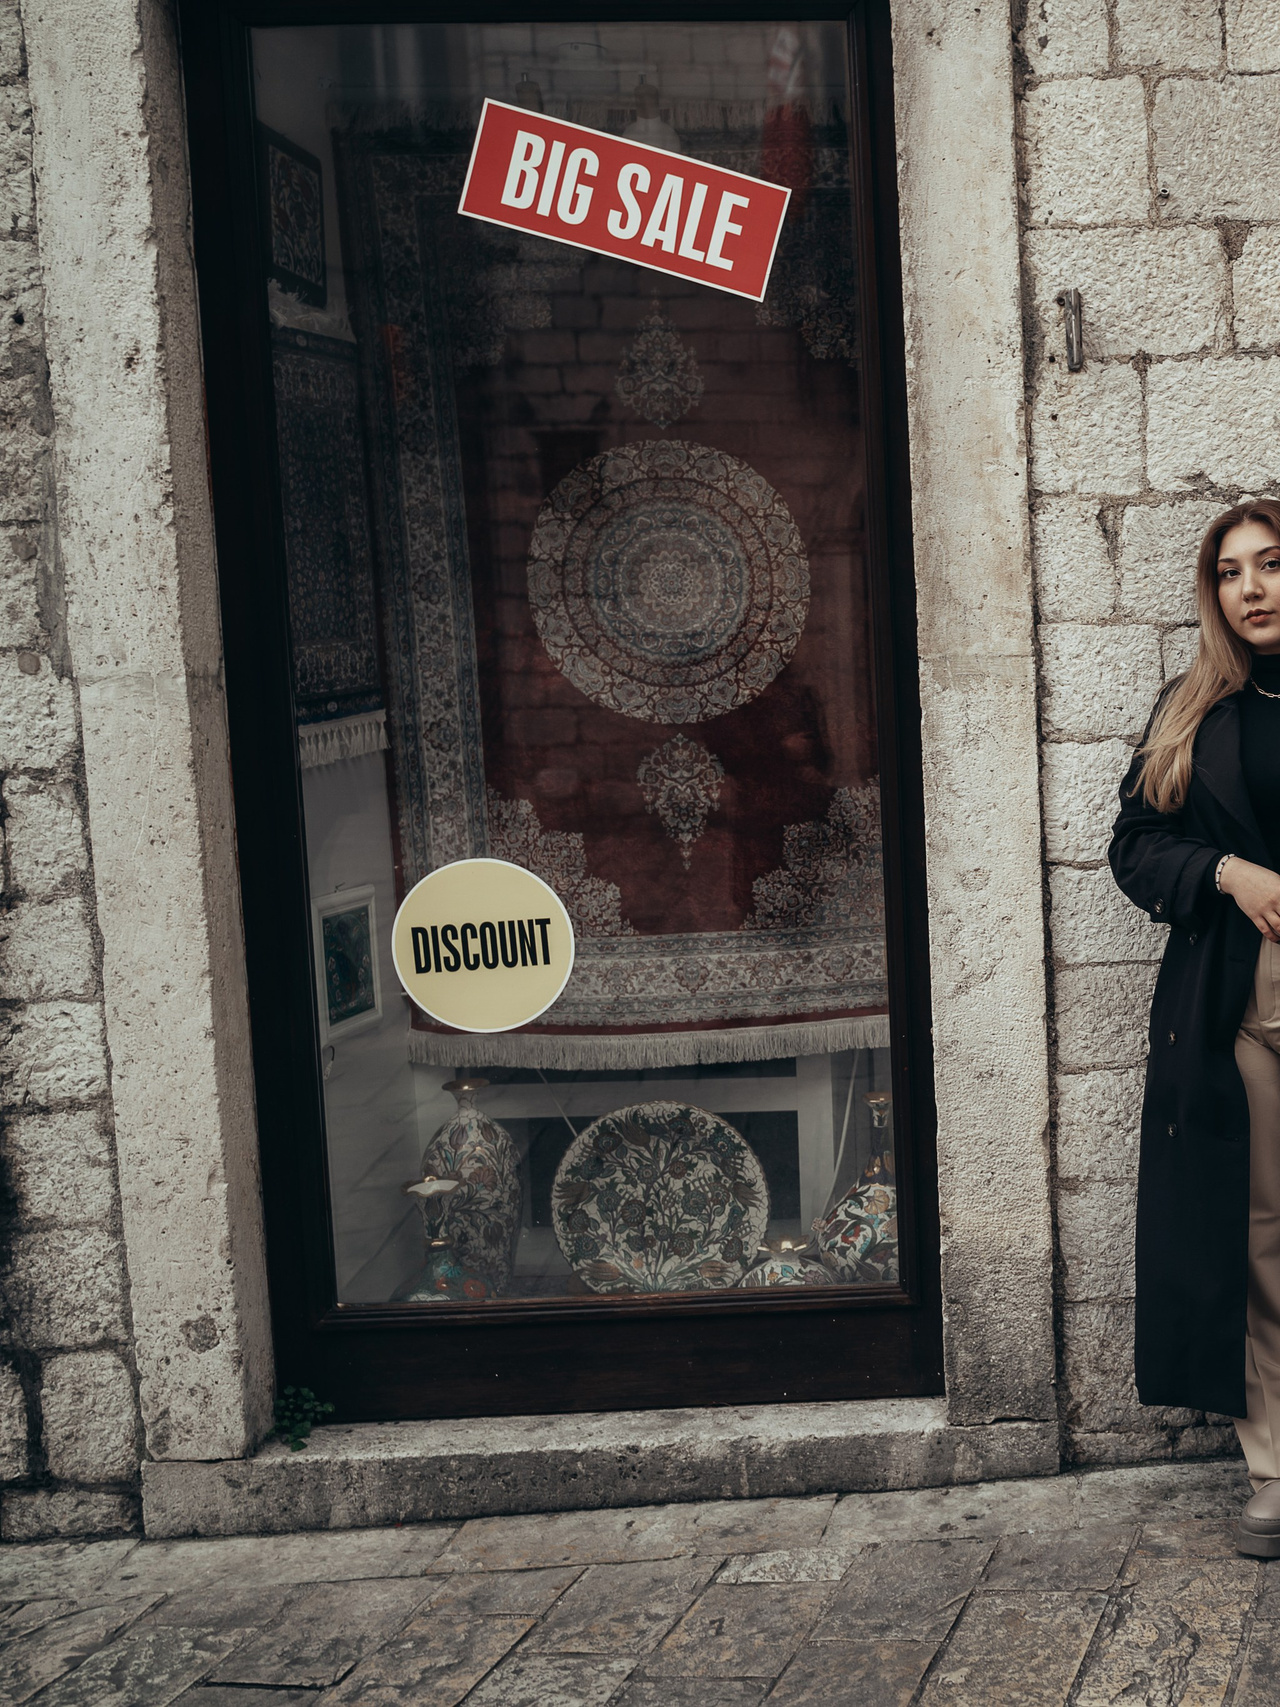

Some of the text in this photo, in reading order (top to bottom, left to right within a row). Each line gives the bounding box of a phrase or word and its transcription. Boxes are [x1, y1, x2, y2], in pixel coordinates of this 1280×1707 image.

[500, 129, 750, 272] BIG SALE
[410, 917, 551, 975] DISCOUNT
